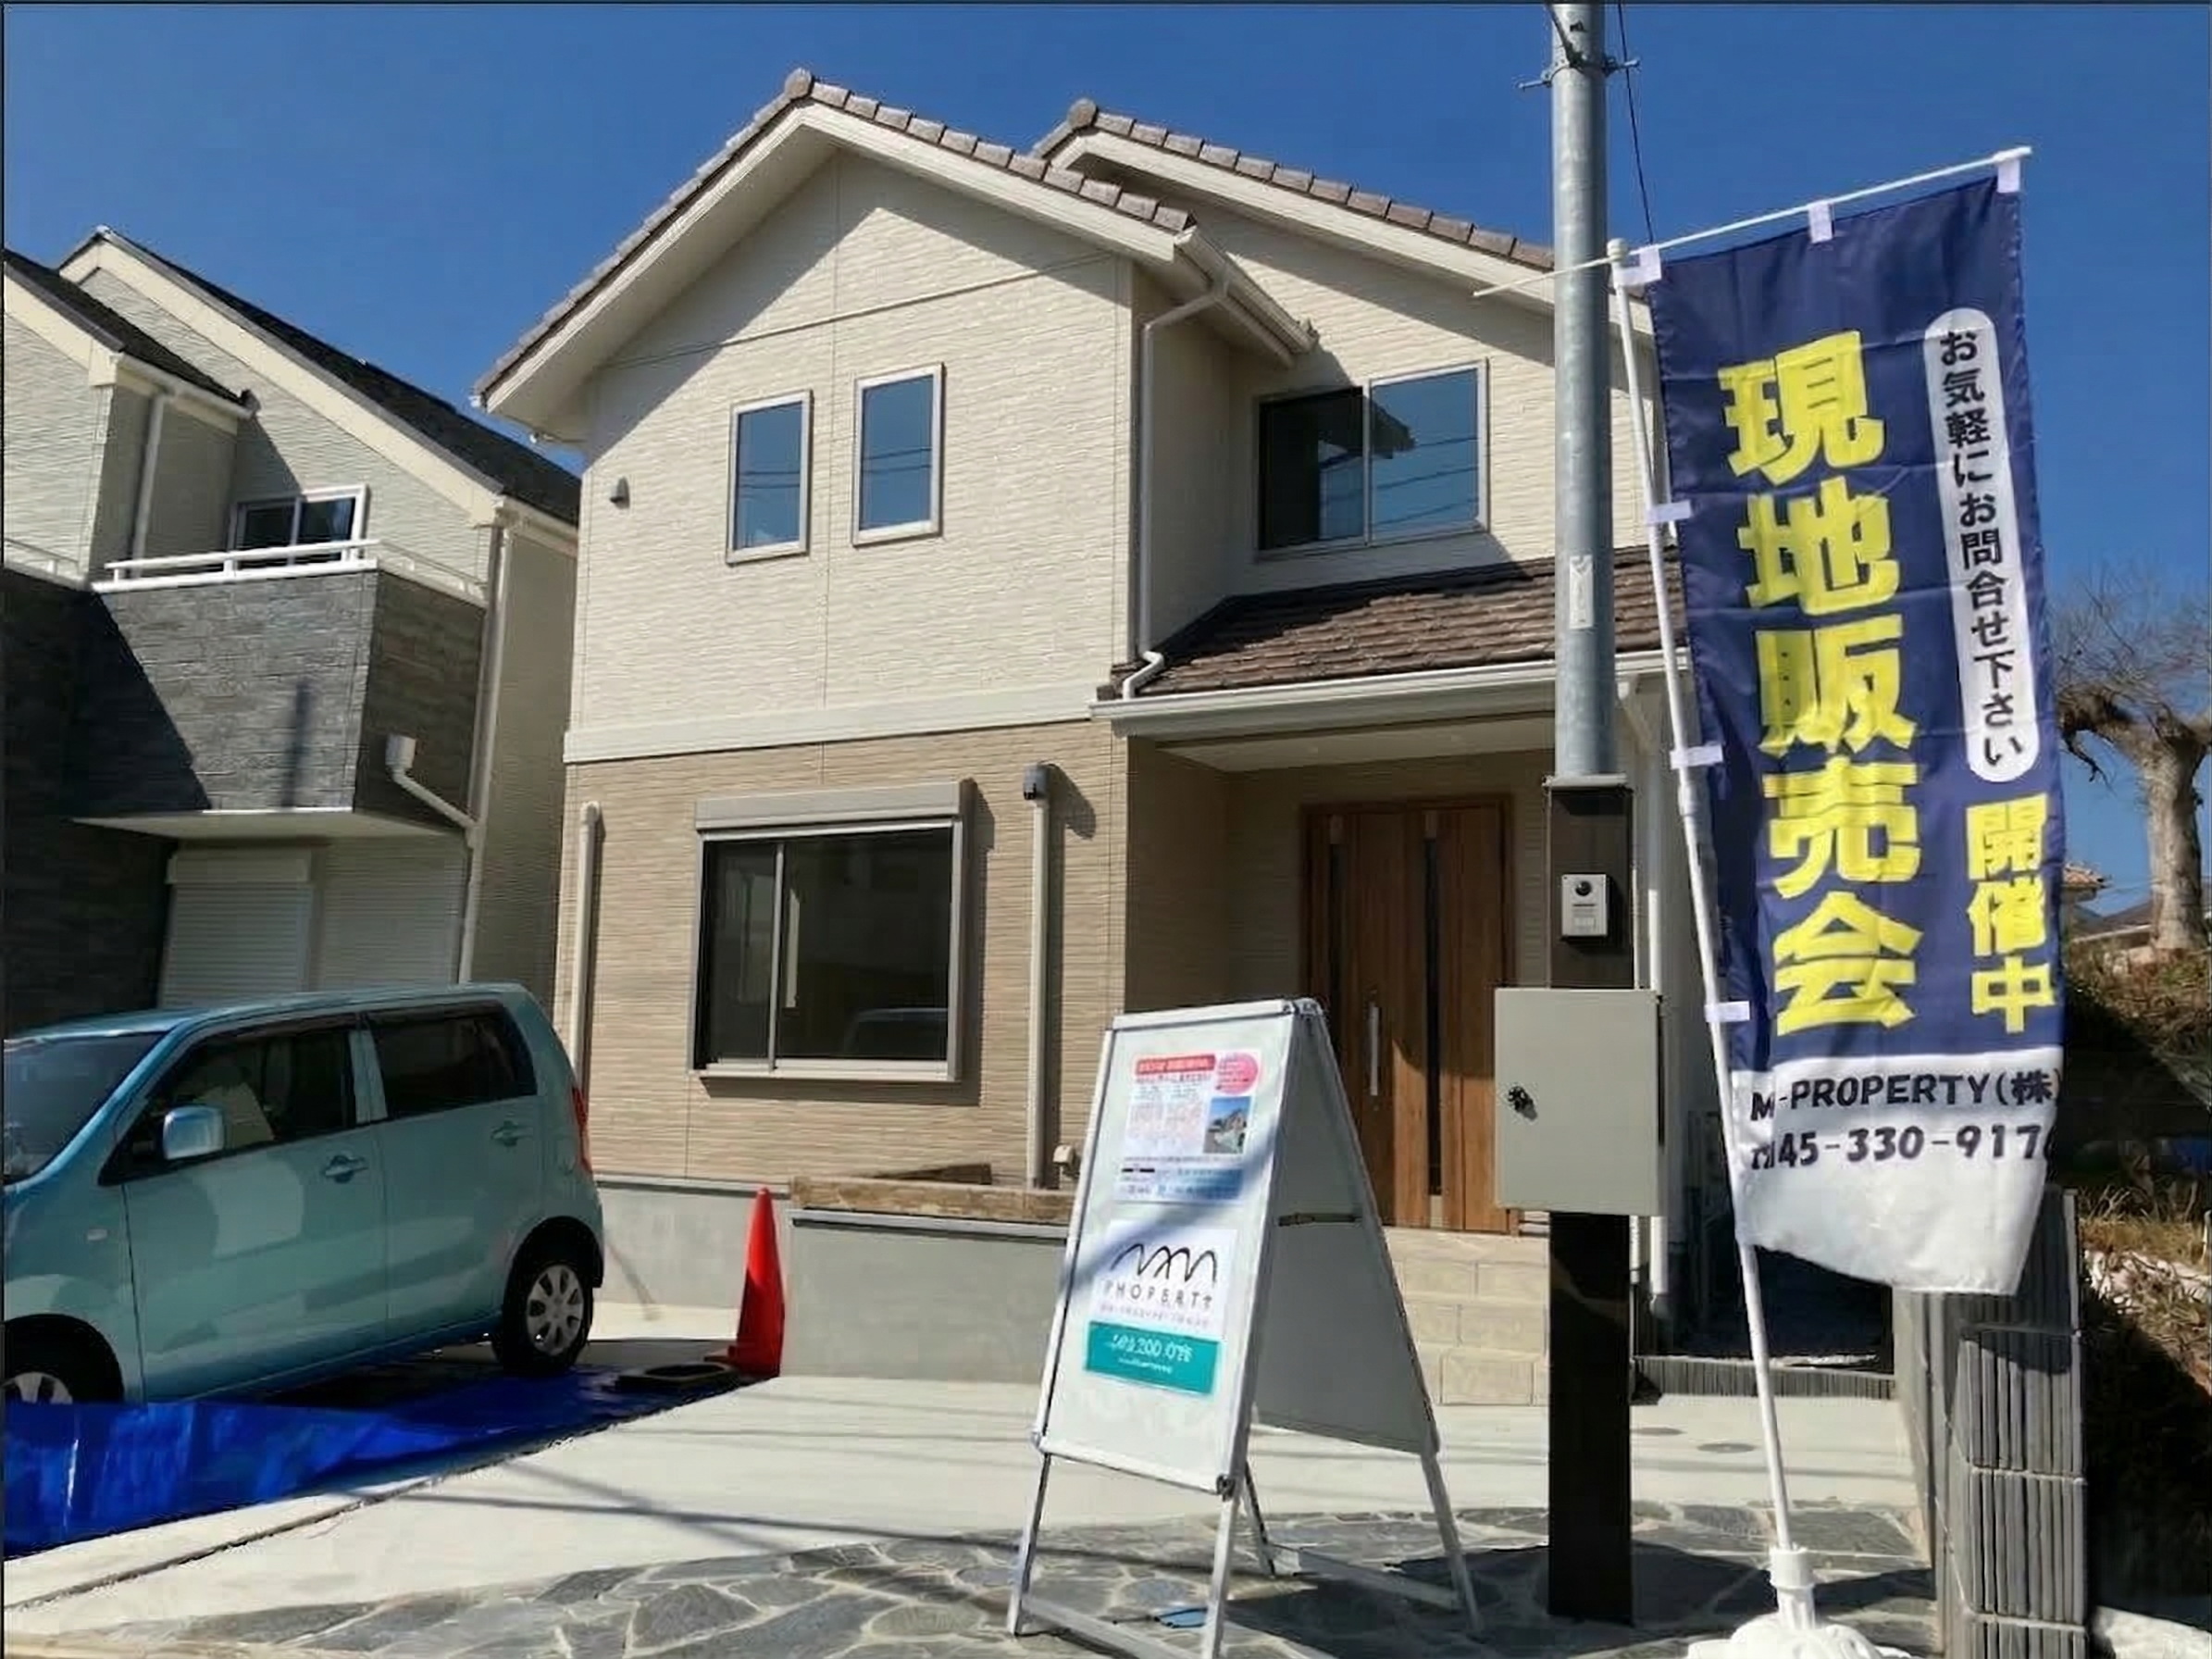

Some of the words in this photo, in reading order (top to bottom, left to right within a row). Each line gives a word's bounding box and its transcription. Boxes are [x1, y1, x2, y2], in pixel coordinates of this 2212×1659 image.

[1718, 330, 1924, 1037] 現地販売会
[1939, 331, 2023, 767] お気軽にお問合せ下さい
[1965, 792, 2056, 1033] 開催中
